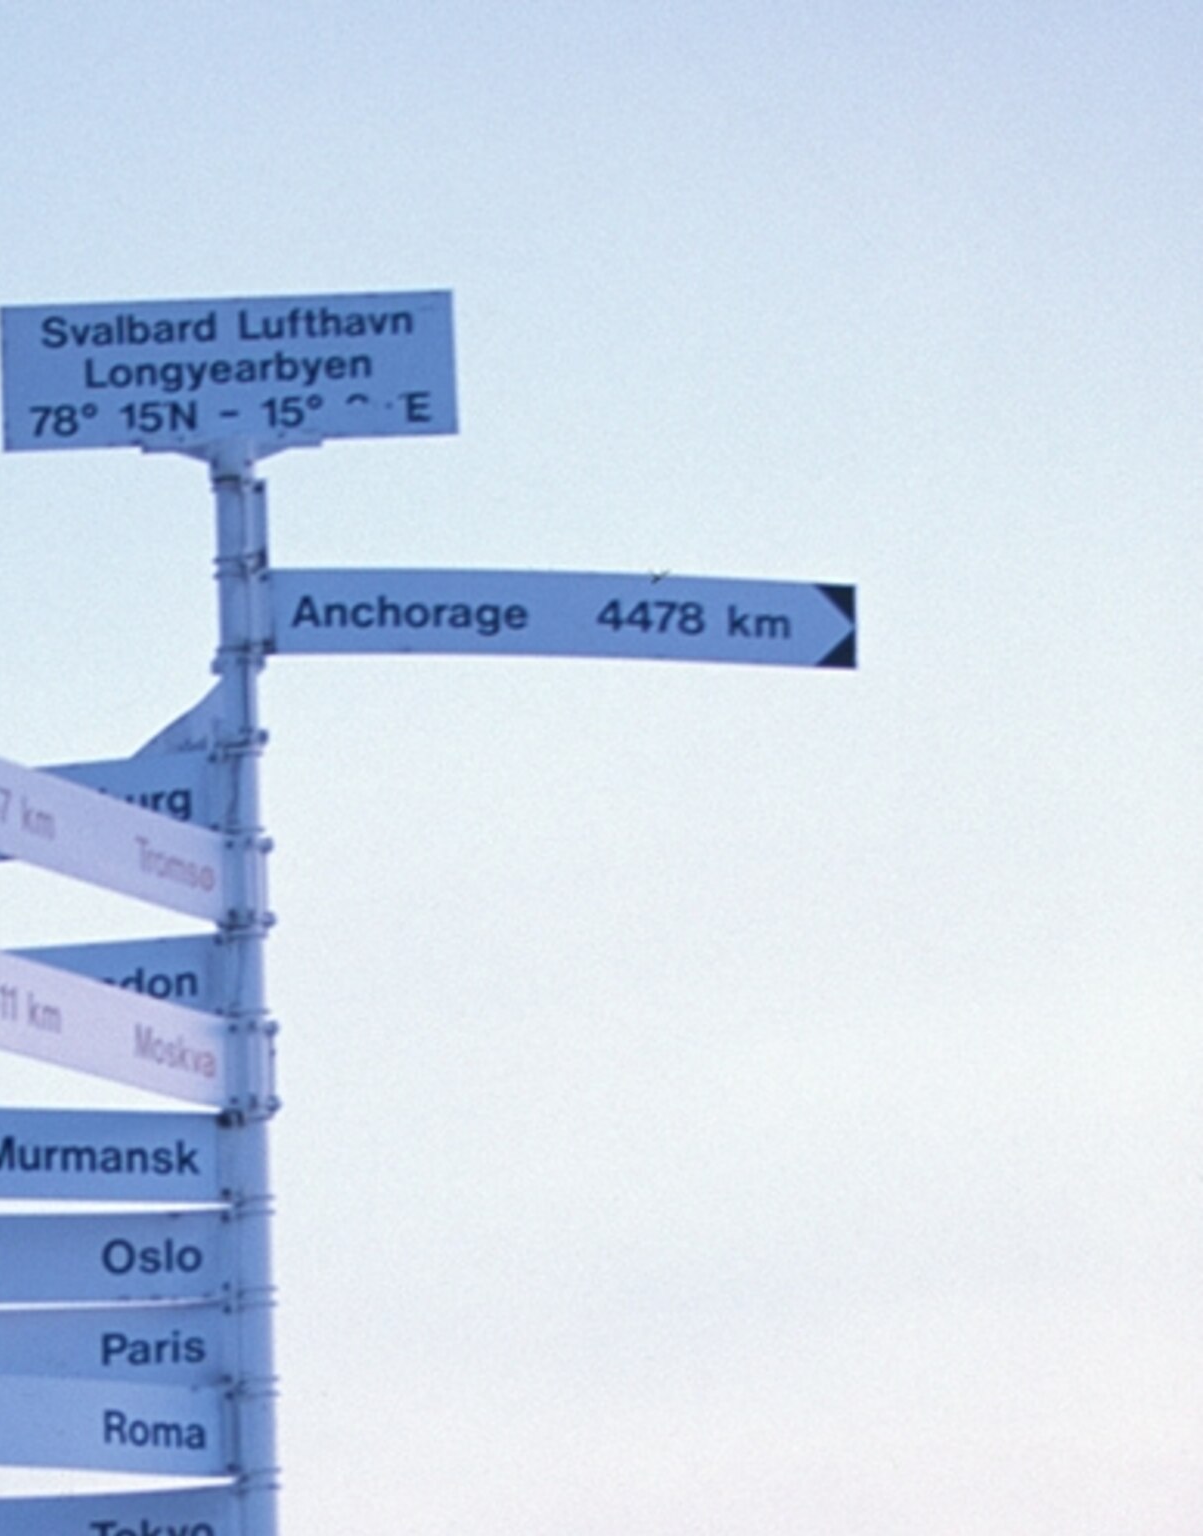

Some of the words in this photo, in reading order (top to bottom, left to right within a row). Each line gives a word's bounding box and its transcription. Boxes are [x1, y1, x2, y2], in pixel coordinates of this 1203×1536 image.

[41, 310, 218, 350] Svalbard
[238, 306, 414, 341] Lufthavn
[84, 350, 373, 393] Longyearbyen
[290, 594, 529, 637] Anchorage
[596, 598, 706, 636] 4478
[727, 604, 791, 639] km
[20, 795, 55, 840] km
[27, 992, 62, 1033] km
[134, 1022, 217, 1077] Moskva
[101, 1237, 204, 1276] Oslo
[101, 1329, 207, 1366] Paris
[103, 1409, 208, 1451] Roma
